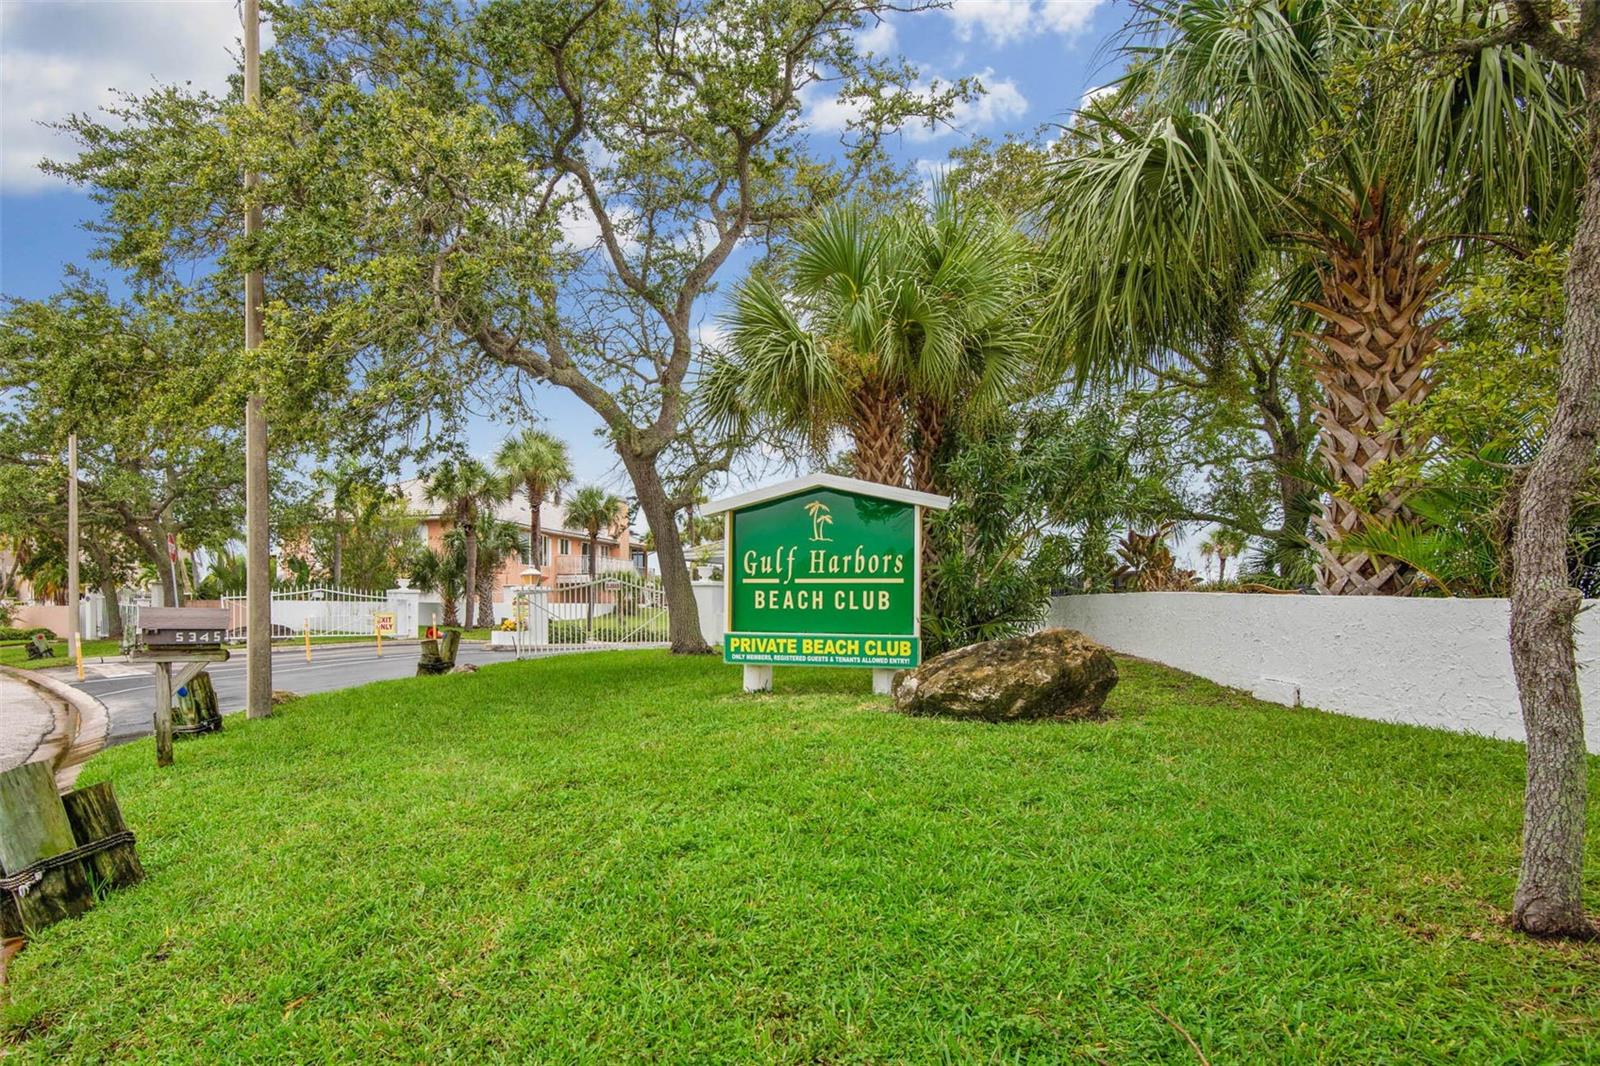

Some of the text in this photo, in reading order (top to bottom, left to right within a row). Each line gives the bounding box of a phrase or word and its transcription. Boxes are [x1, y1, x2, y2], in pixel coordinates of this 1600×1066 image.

[743, 545, 904, 585] Gulf Harbors
[754, 590, 890, 610] BEACH CLUB
[175, 631, 221, 642] 5345
[730, 637, 912, 656] PRIVATE BEACH CLUB
